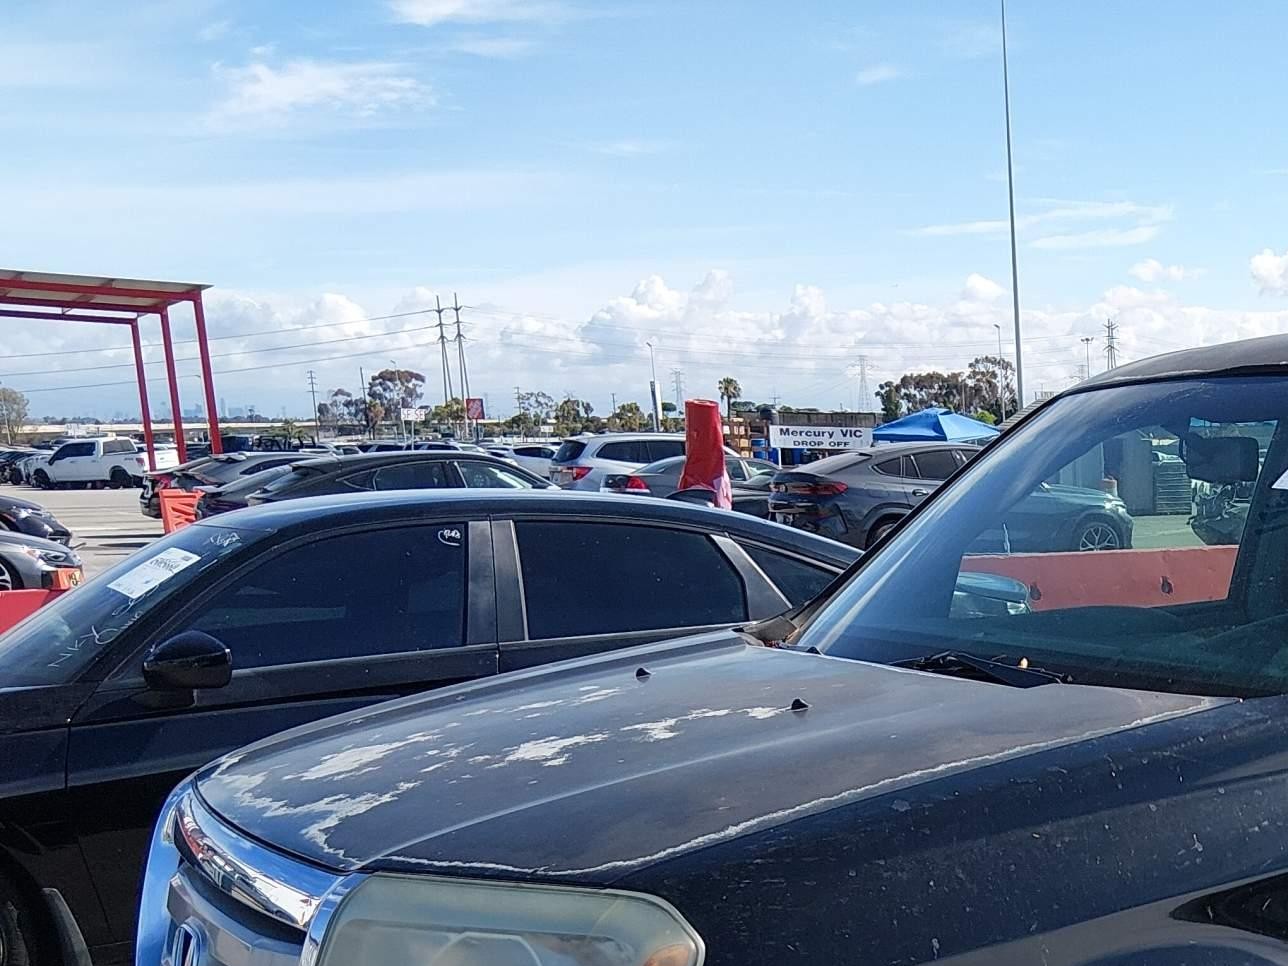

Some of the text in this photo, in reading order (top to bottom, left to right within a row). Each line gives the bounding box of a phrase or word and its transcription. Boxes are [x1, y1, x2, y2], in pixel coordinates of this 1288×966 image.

[779, 428, 863, 439] Mercury VIC
[792, 440, 851, 448] DROP OFF
